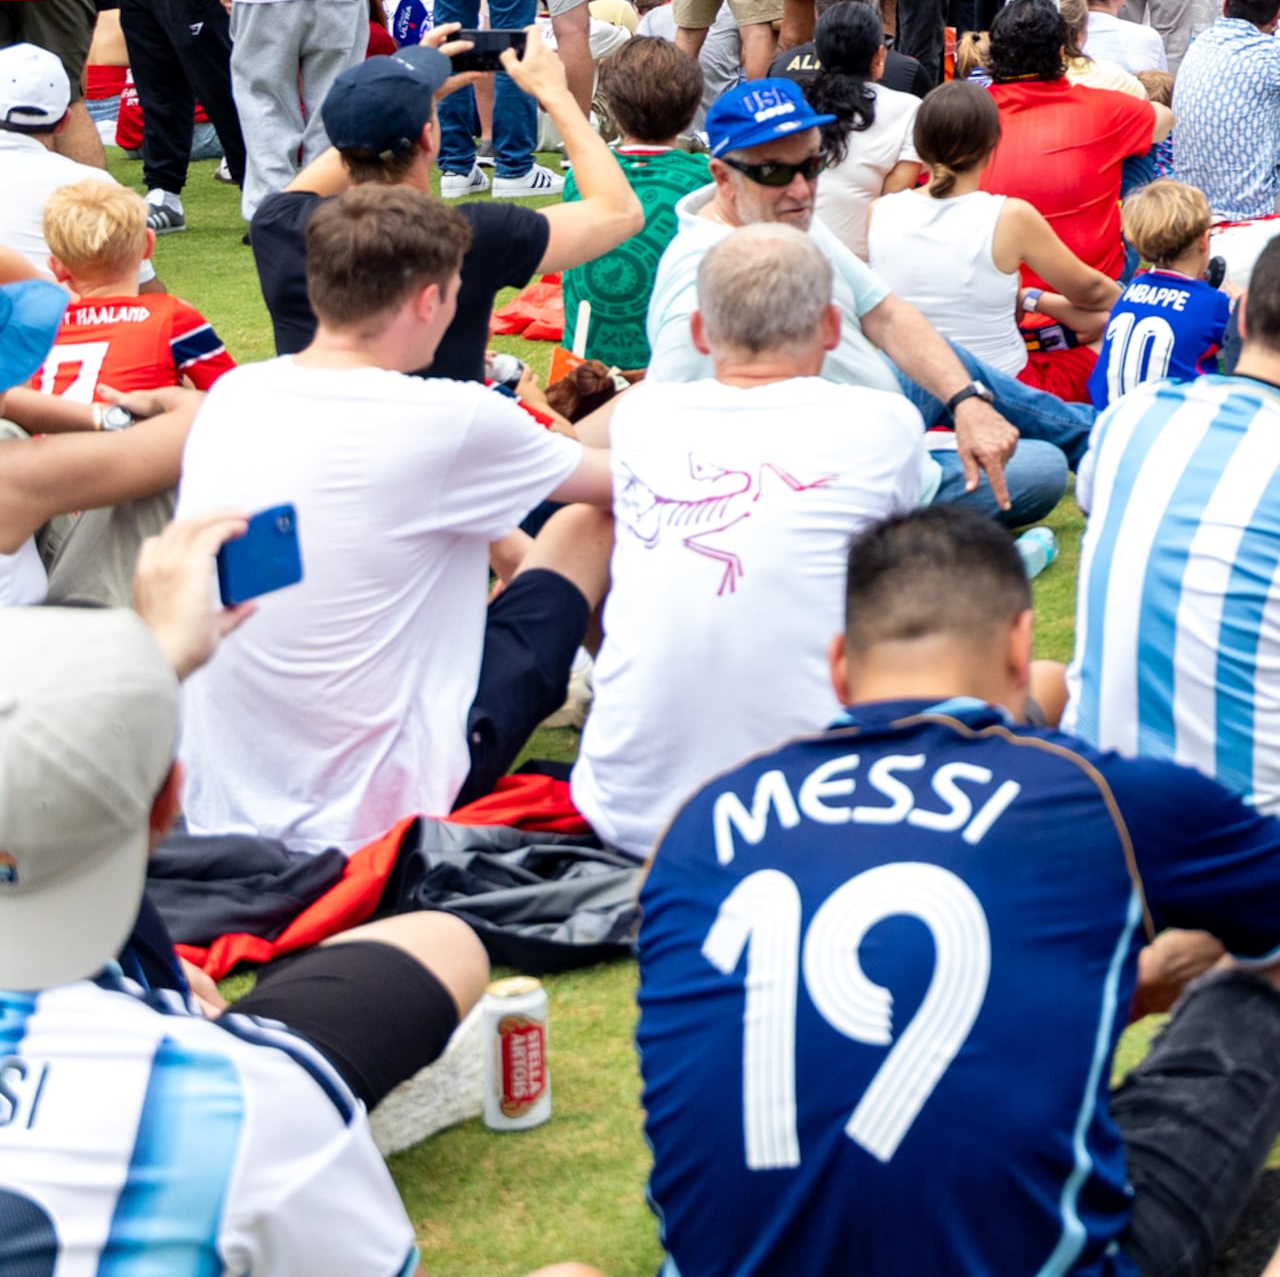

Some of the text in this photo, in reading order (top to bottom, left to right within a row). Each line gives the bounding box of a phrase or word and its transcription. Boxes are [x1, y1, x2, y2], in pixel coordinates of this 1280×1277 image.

[400, 5, 412, 39] ULTRA
[743, 87, 792, 113] USA
[77, 306, 151, 326] HAALAND
[1122, 283, 1191, 312] MBAPPE
[1105, 311, 1175, 405] 10
[713, 753, 1021, 866] MESSI
[701, 860, 992, 1171] 19
[511, 1033, 528, 1098] ARTOIS
[527, 1028, 543, 1094] STELLA
